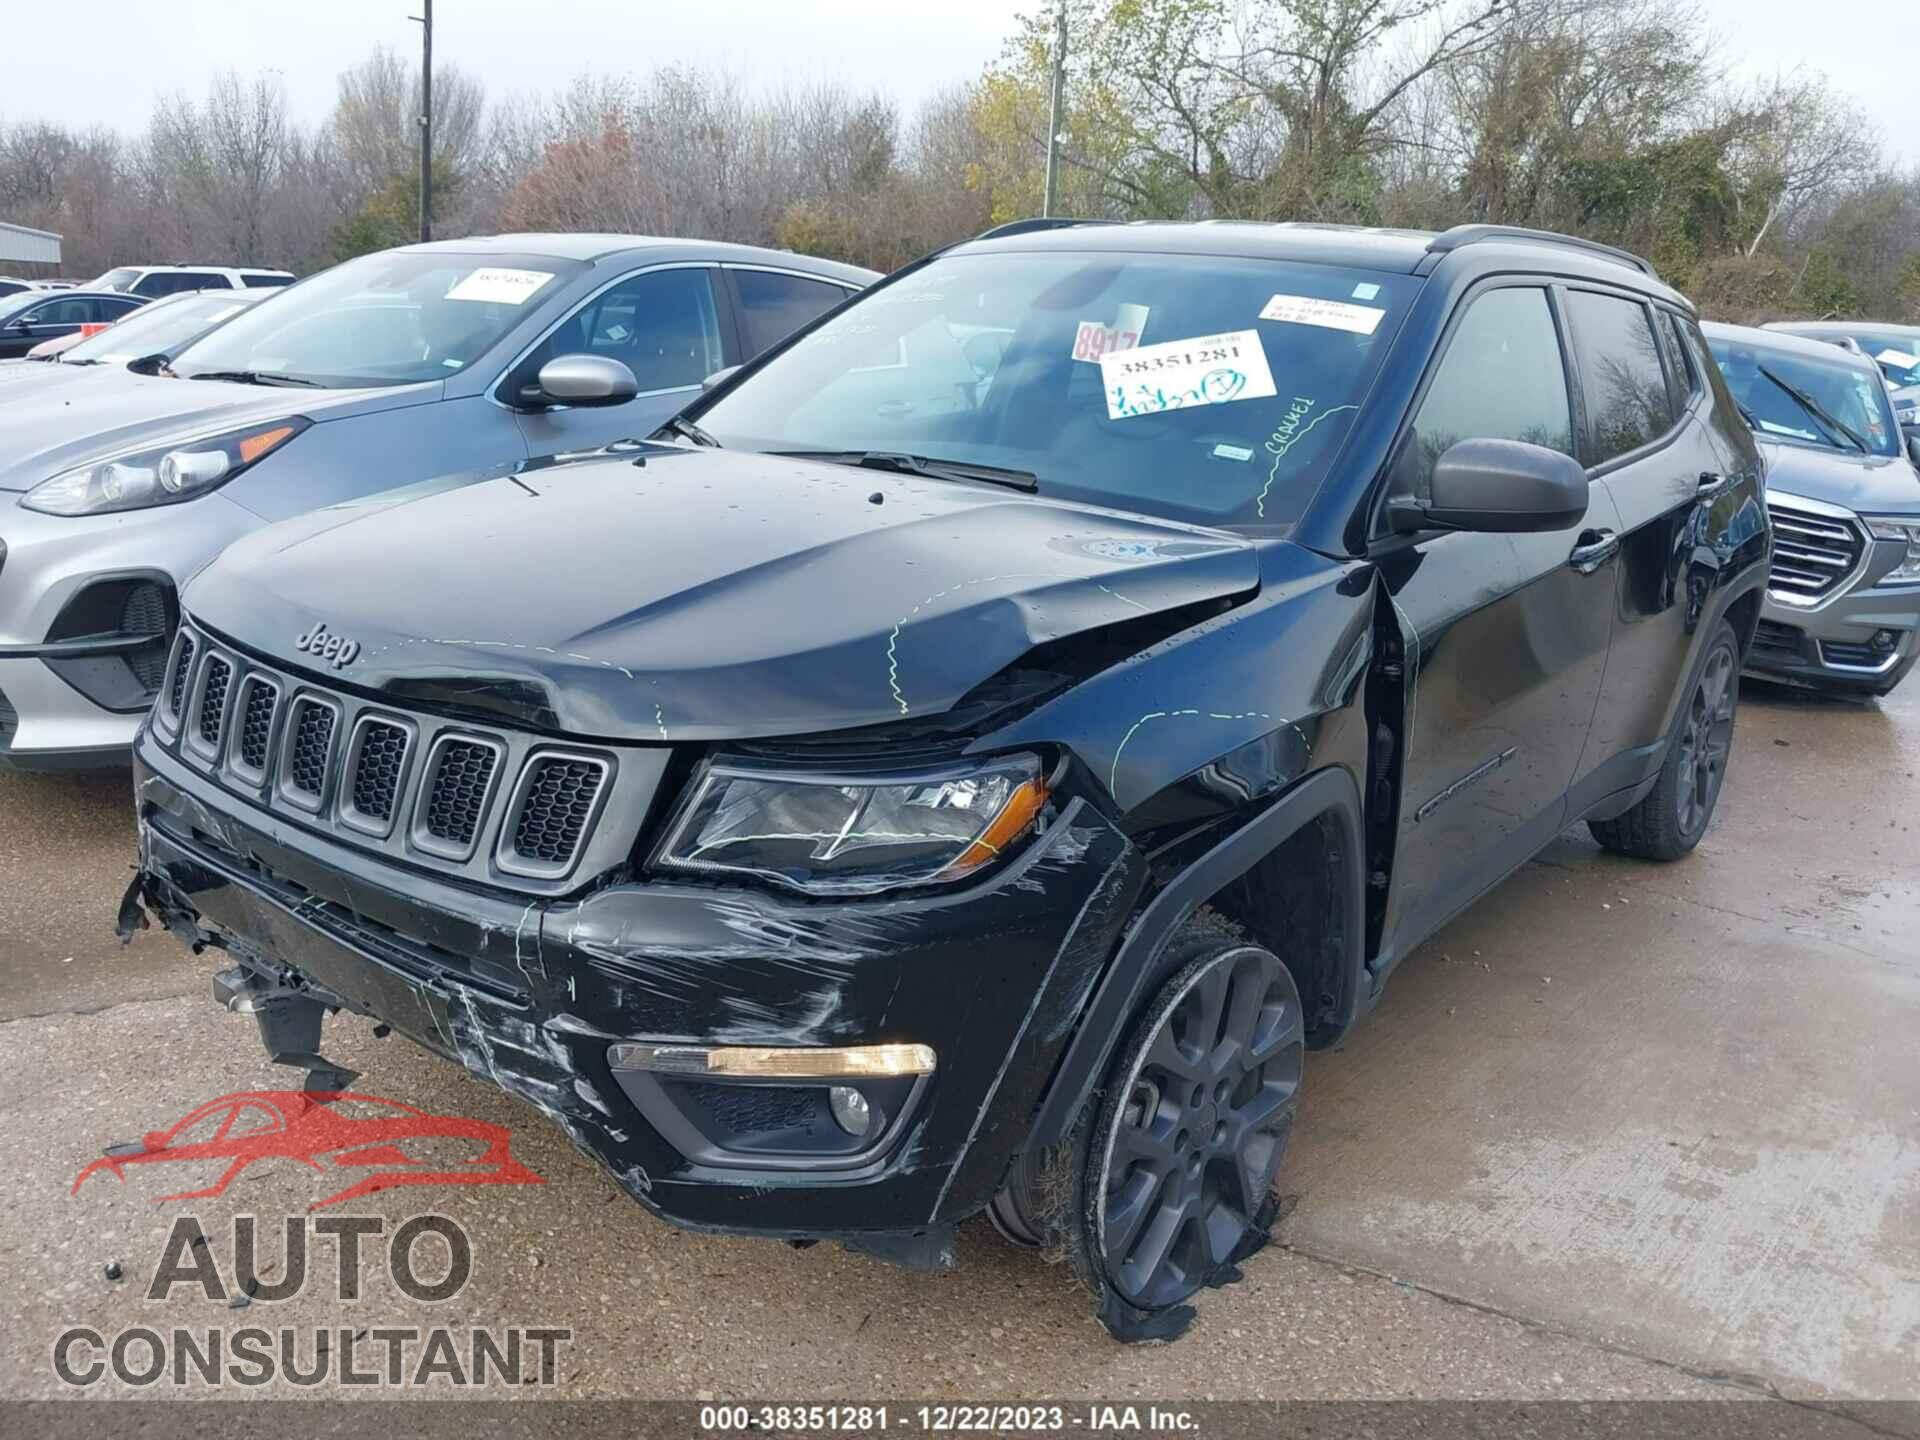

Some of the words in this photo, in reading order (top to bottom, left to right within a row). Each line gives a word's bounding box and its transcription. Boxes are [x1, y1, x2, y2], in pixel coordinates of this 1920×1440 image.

[1075, 326, 1137, 361] 8917
[1119, 346, 1241, 376] 38351281
[296, 621, 360, 669] Jeep
